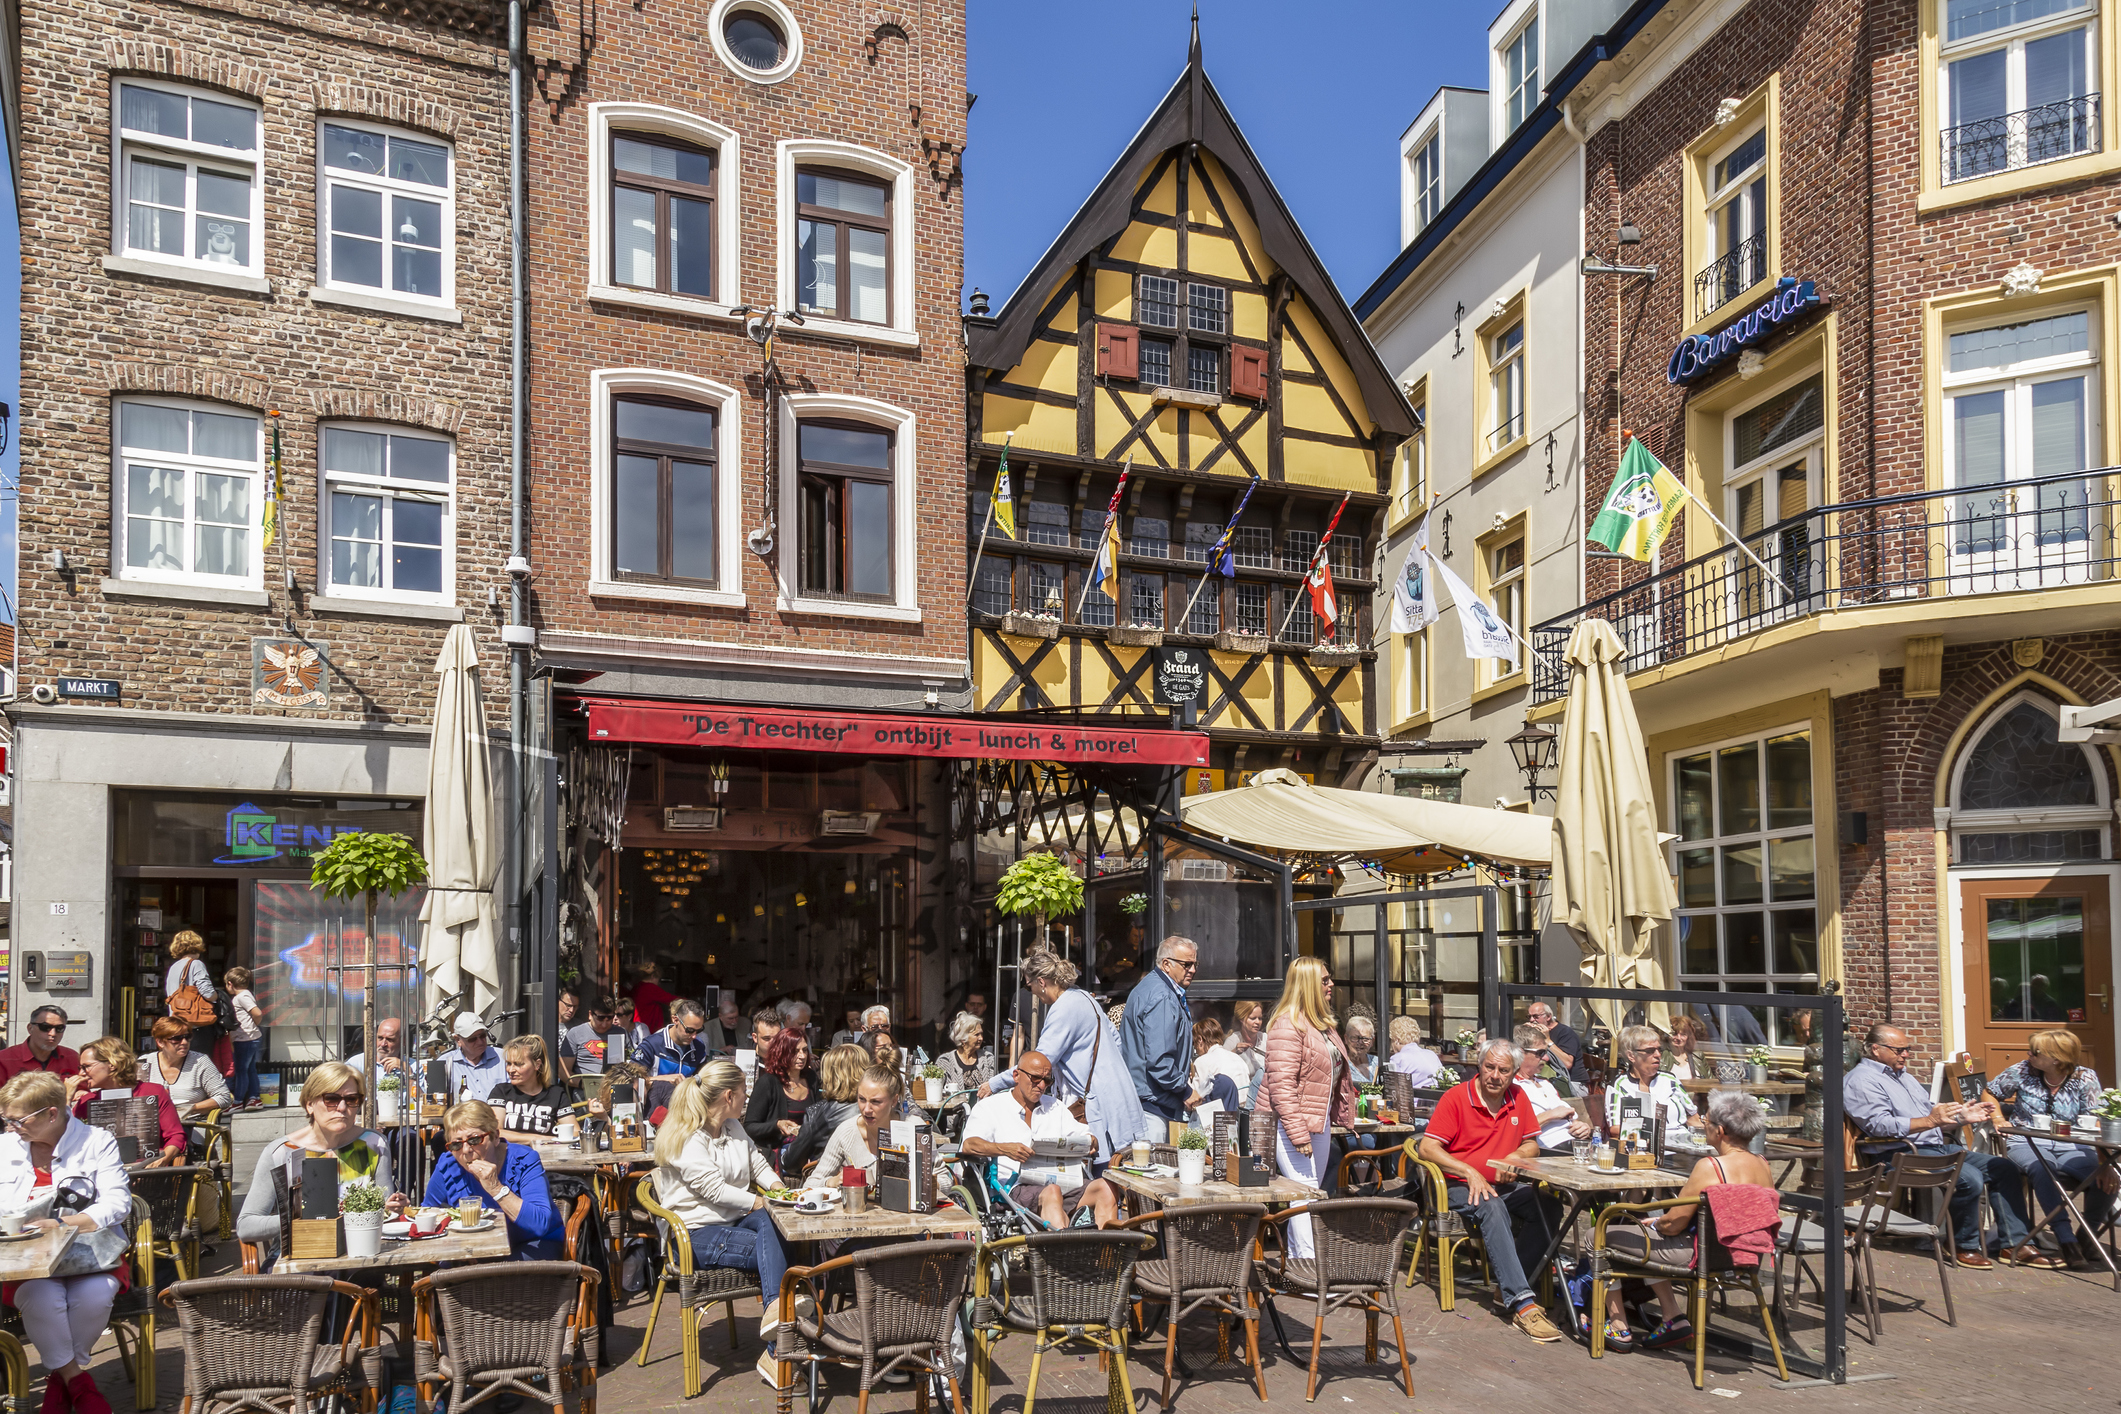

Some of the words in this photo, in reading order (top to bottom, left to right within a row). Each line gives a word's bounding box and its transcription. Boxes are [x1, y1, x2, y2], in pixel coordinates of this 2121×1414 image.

[1667, 279, 1809, 384] Bavaria
[1405, 604, 1423, 617] Sitta
[1163, 659, 1200, 674] Brand
[67, 681, 109, 693] MARKT
[267, 689, 278, 700] IM
[290, 693, 313, 705] GEIST
[682, 714, 729, 735] "De
[737, 717, 859, 741] Trechter"
[875, 727, 952, 750] ontbijt
[979, 731, 1041, 749] lunch
[1050, 734, 1066, 751] &
[1075, 737, 1137, 753] more!
[1421, 783, 1440, 795] De
[54, 904, 65, 914] 18
[504, 1101, 552, 1133] NYC
